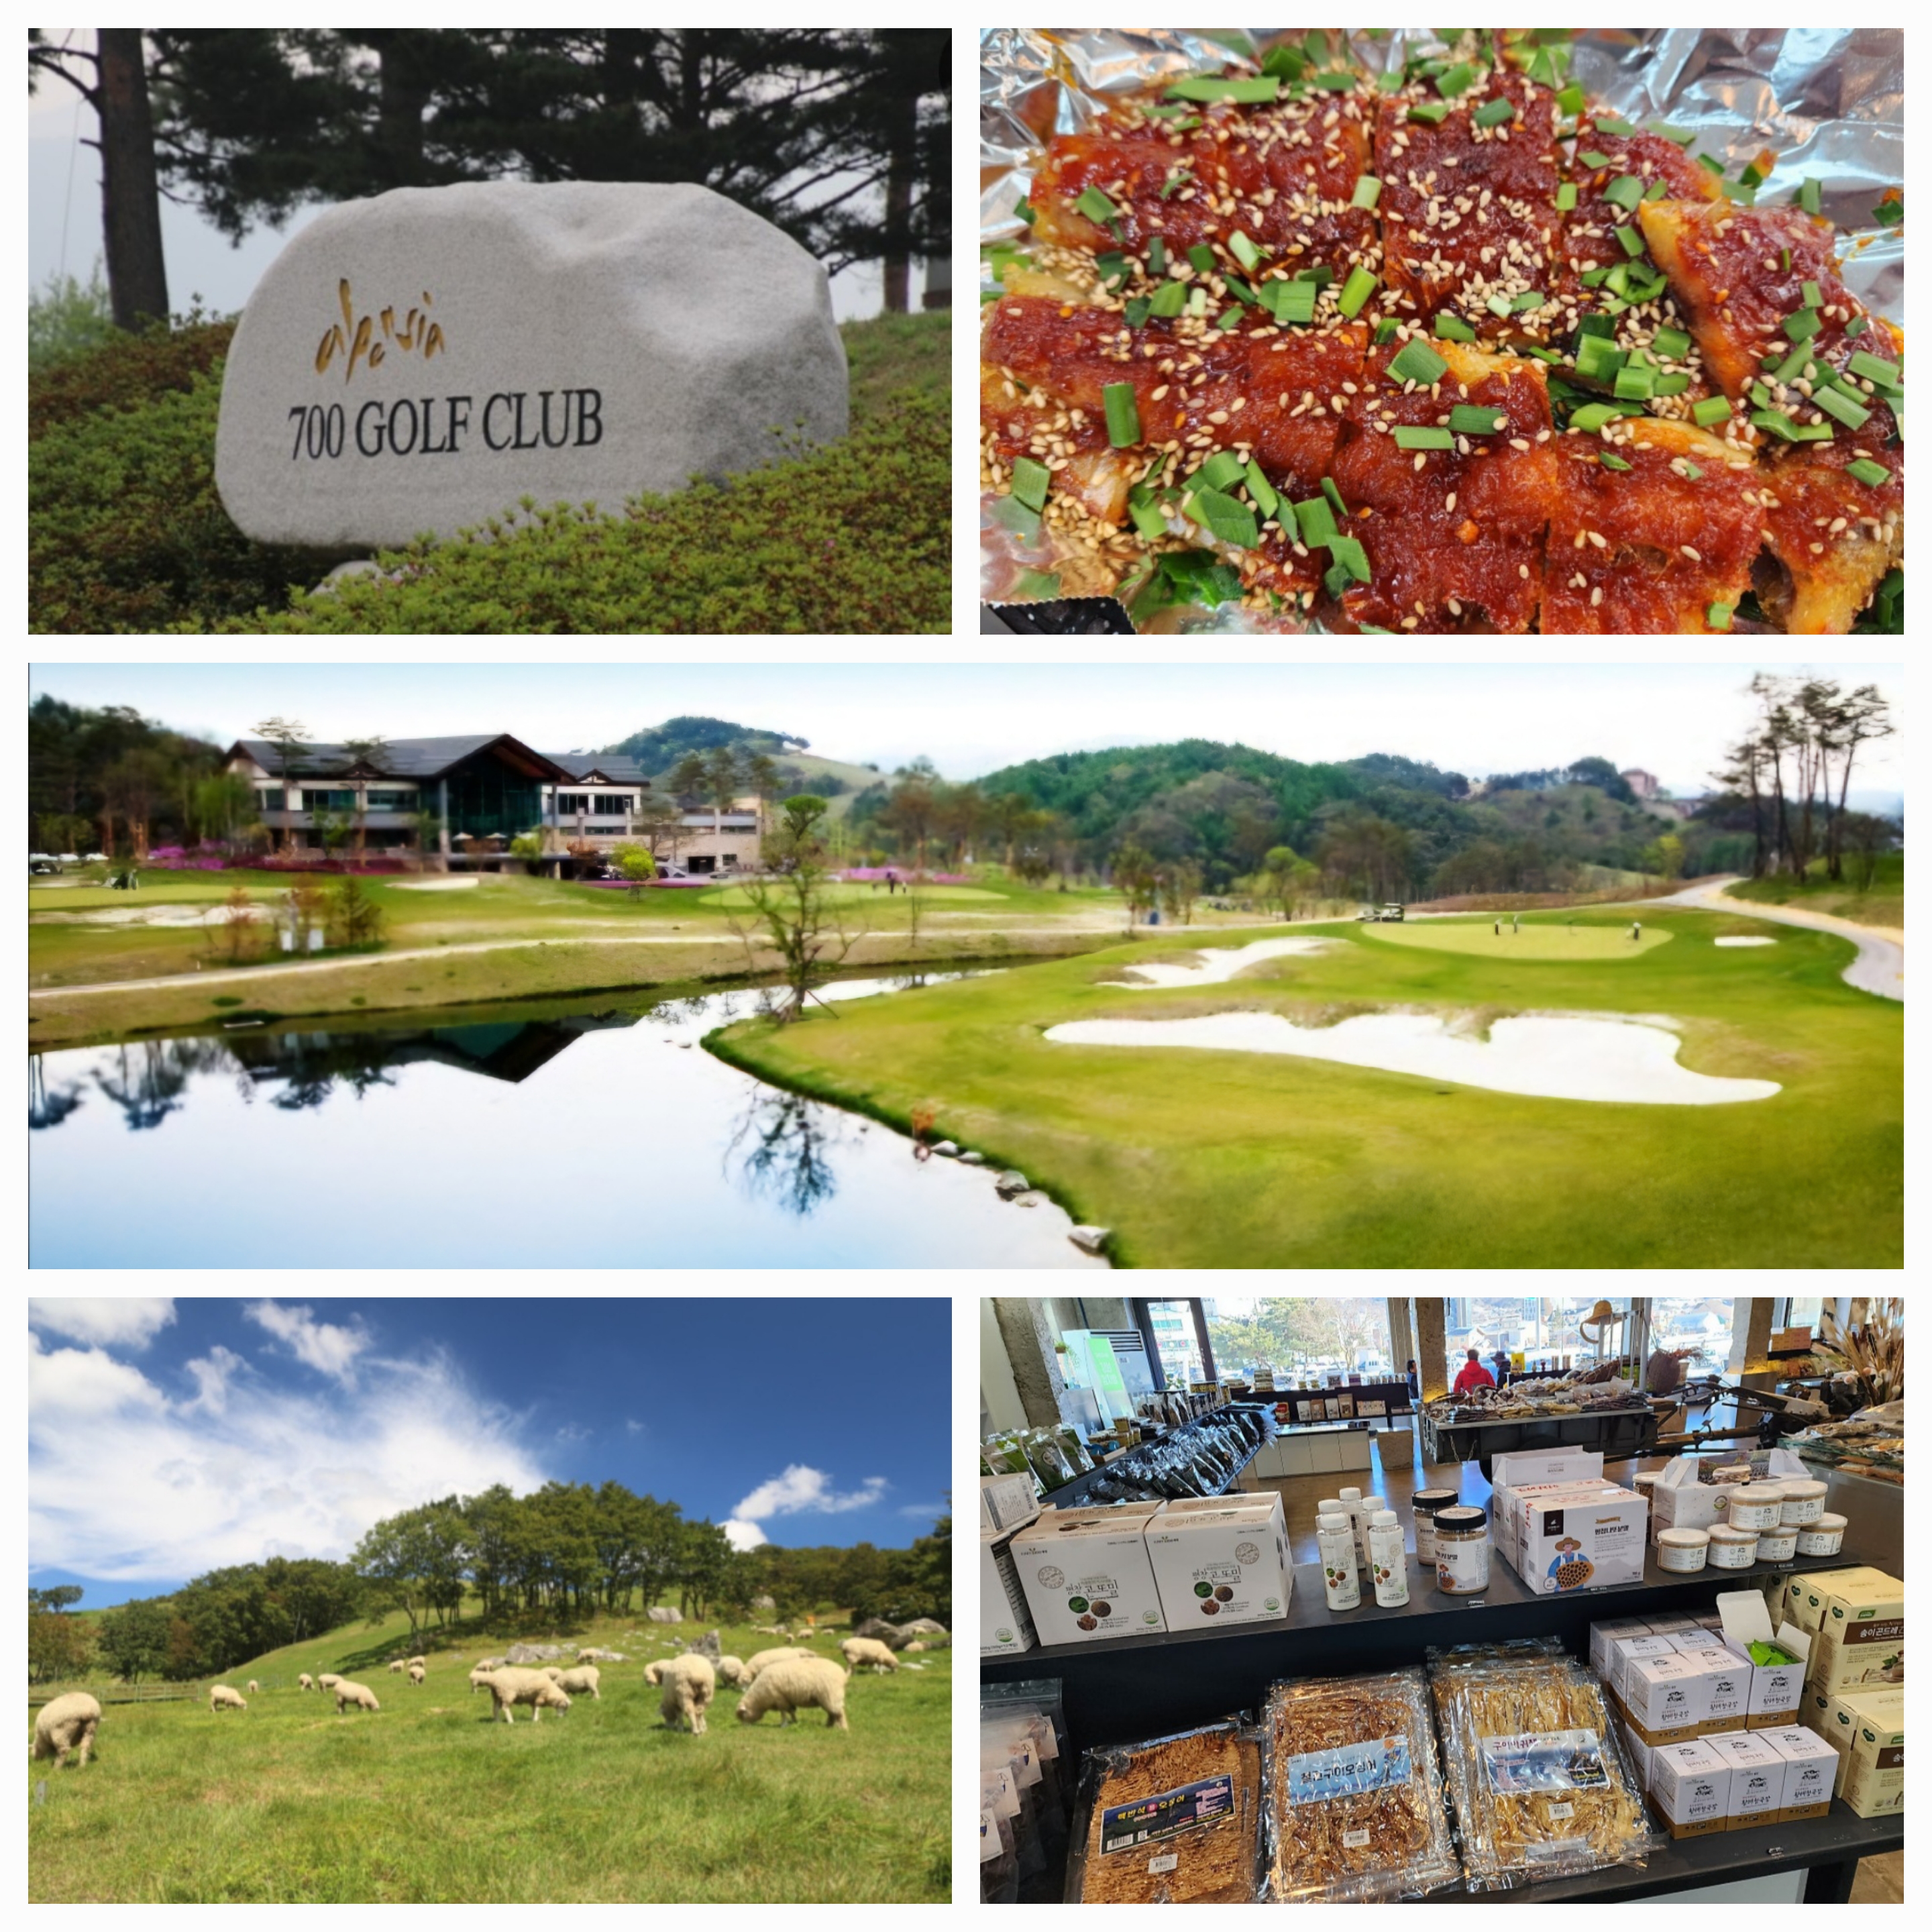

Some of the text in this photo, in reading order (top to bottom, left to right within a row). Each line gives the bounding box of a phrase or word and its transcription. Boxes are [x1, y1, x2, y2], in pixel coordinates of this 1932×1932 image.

[288, 388, 603, 460] 700 GOLF CLUB
